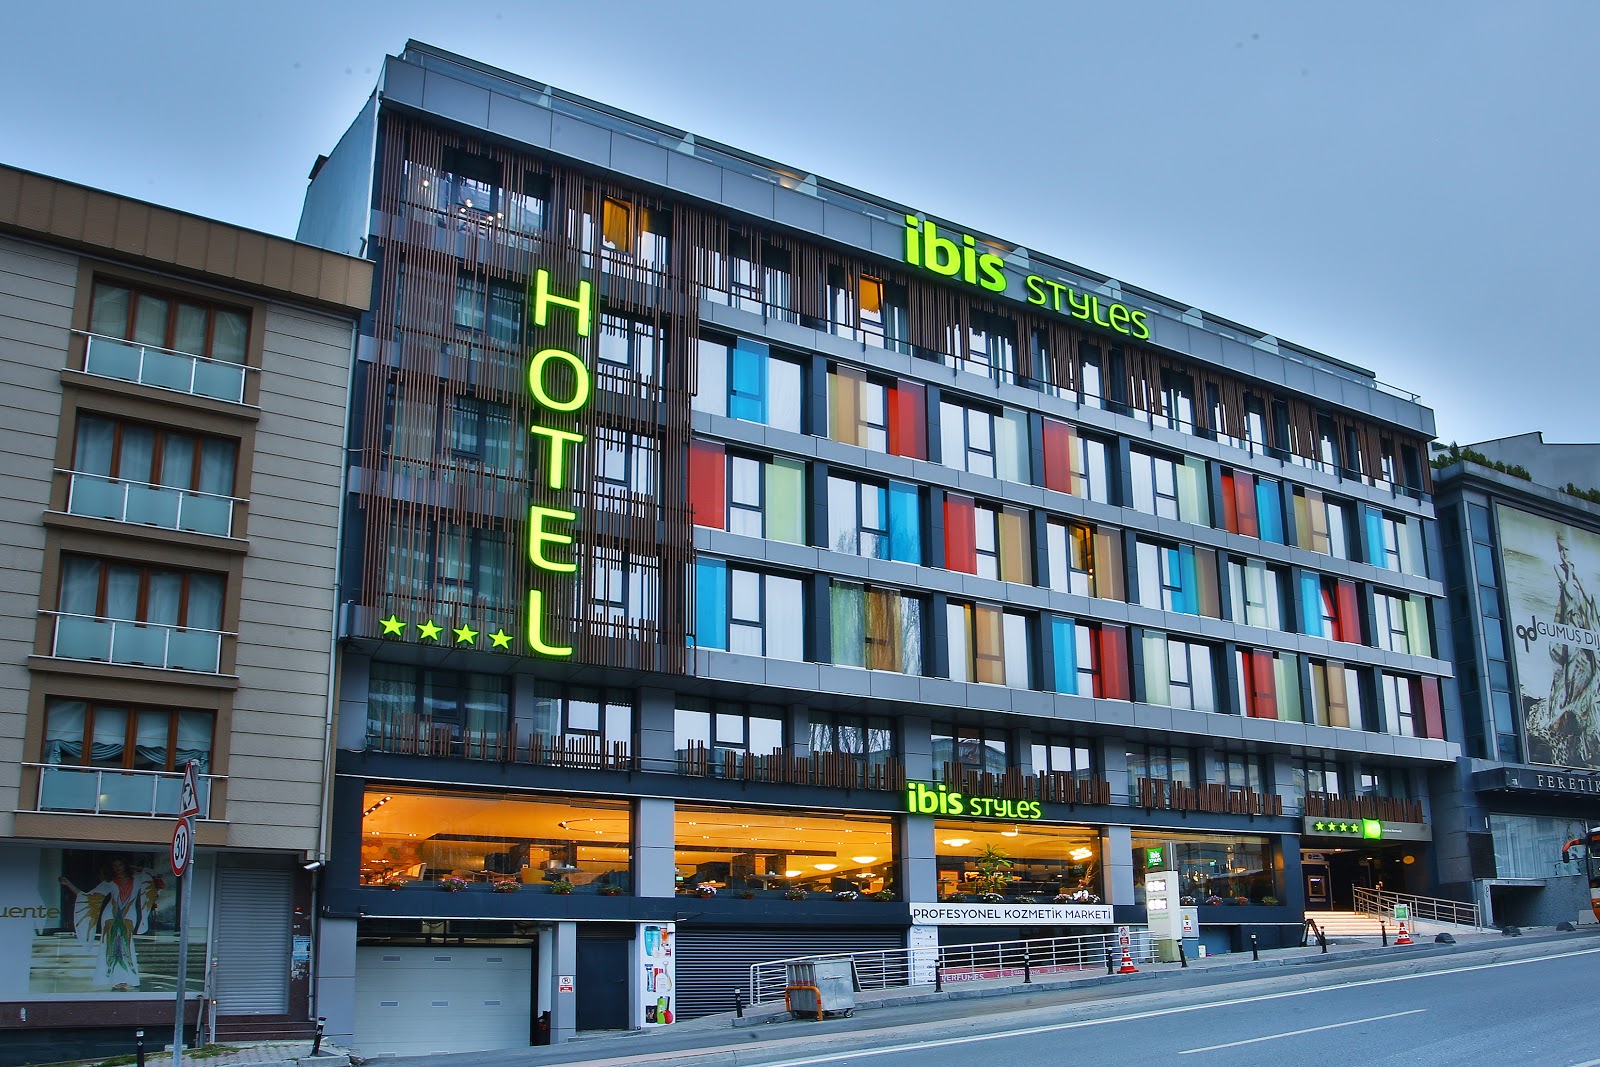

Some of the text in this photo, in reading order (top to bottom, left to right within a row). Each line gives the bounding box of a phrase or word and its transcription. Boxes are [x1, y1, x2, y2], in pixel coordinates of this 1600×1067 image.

[905, 214, 1008, 292] ibis
[528, 268, 592, 658] HOTEL
[908, 782, 963, 815] ibis
[175, 832, 185, 860] 30
[913, 907, 1111, 920] PROFESYONEL KOZMETİK MARKETİ
